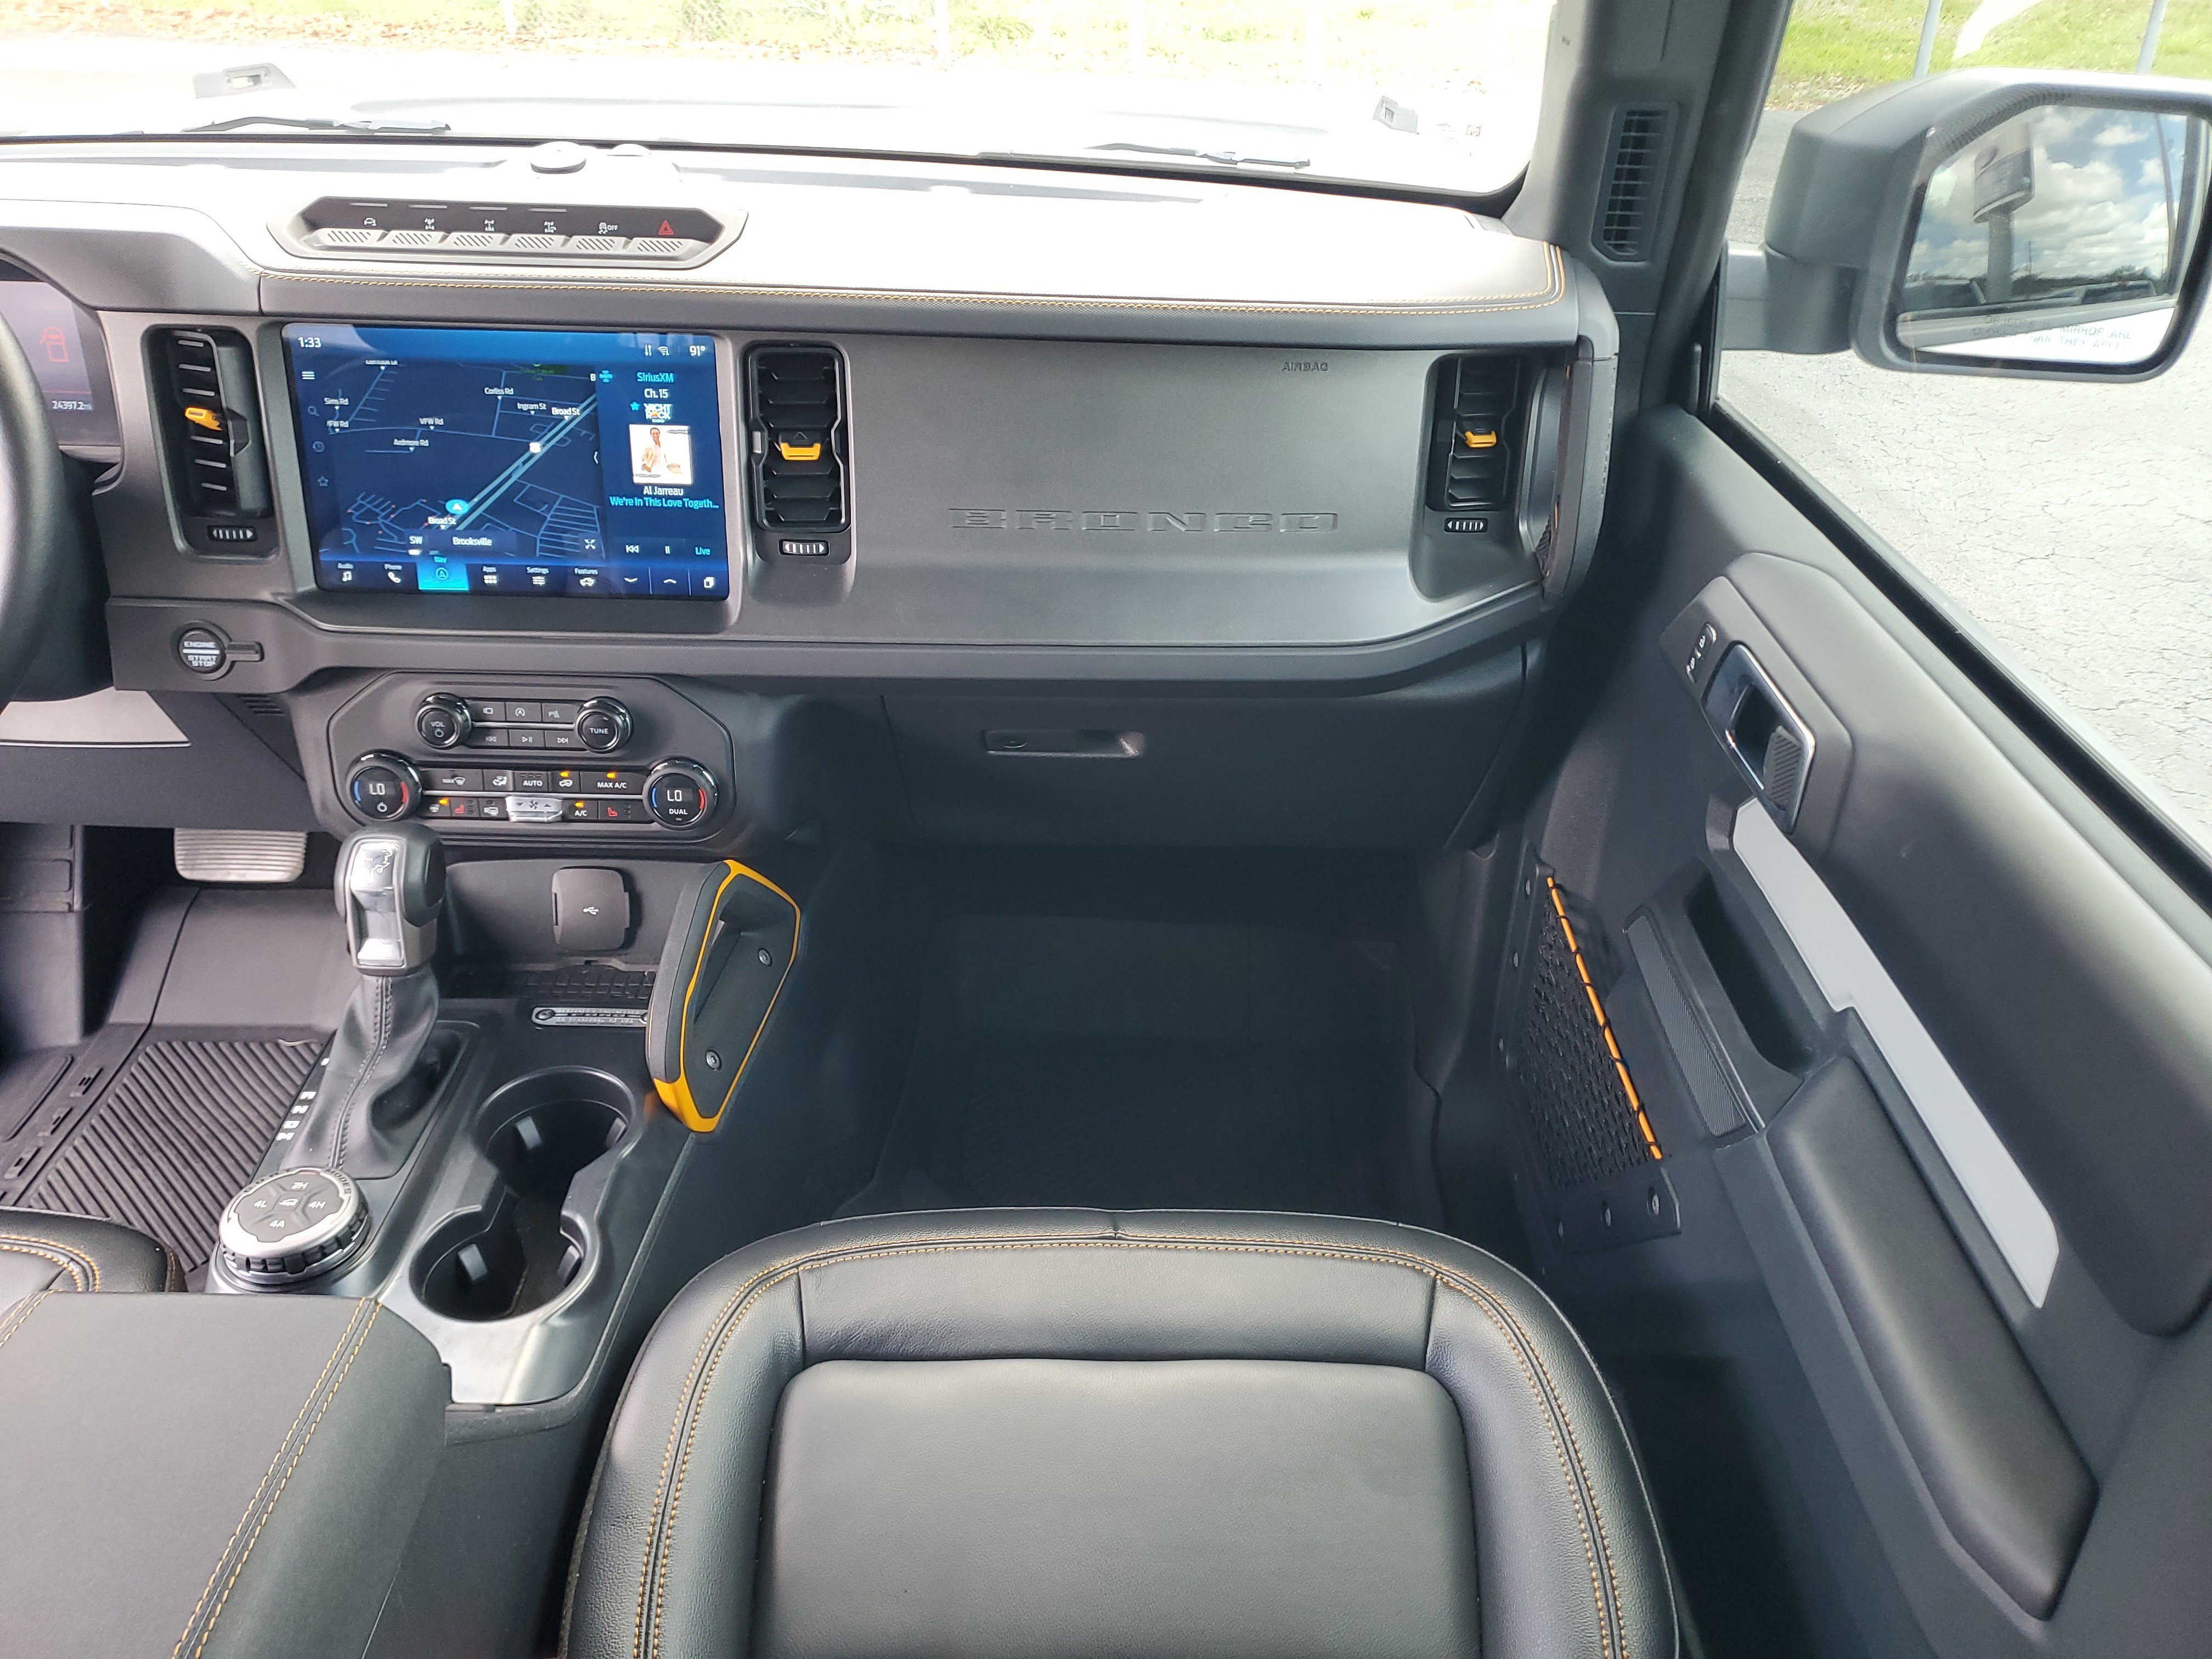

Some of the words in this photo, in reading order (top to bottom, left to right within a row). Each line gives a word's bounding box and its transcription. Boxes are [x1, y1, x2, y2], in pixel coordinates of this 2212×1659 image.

[298, 337, 322, 348] 1:33
[1282, 362, 1328, 371] AIRBAG
[636, 372, 675, 383] SiriusXM
[517, 403, 539, 411] Ingram
[551, 407, 572, 416] Broad
[572, 408, 581, 416] St
[434, 417, 444, 426] Rd
[643, 486, 652, 495] Al
[653, 486, 684, 496] Jarreau
[609, 496, 634, 506] We're
[635, 497, 643, 506] In
[643, 497, 662, 507] This
[662, 498, 682, 507] Love
[427, 516, 444, 525] Broad
[444, 517, 456, 525] St
[947, 507, 1339, 533] BRONCO
[409, 535, 423, 545] SW
[452, 537, 493, 546] Brooksville
[695, 546, 711, 556] Live
[526, 566, 550, 575] Settings
[574, 567, 599, 575] Features
[368, 783, 386, 796] LO
[614, 781, 628, 789] A/C
[667, 789, 682, 802] LO
[291, 1182, 309, 1190] 2H
[253, 1200, 268, 1208] 4L
[308, 1201, 327, 1209] 4H
[269, 1220, 285, 1228] 4A
